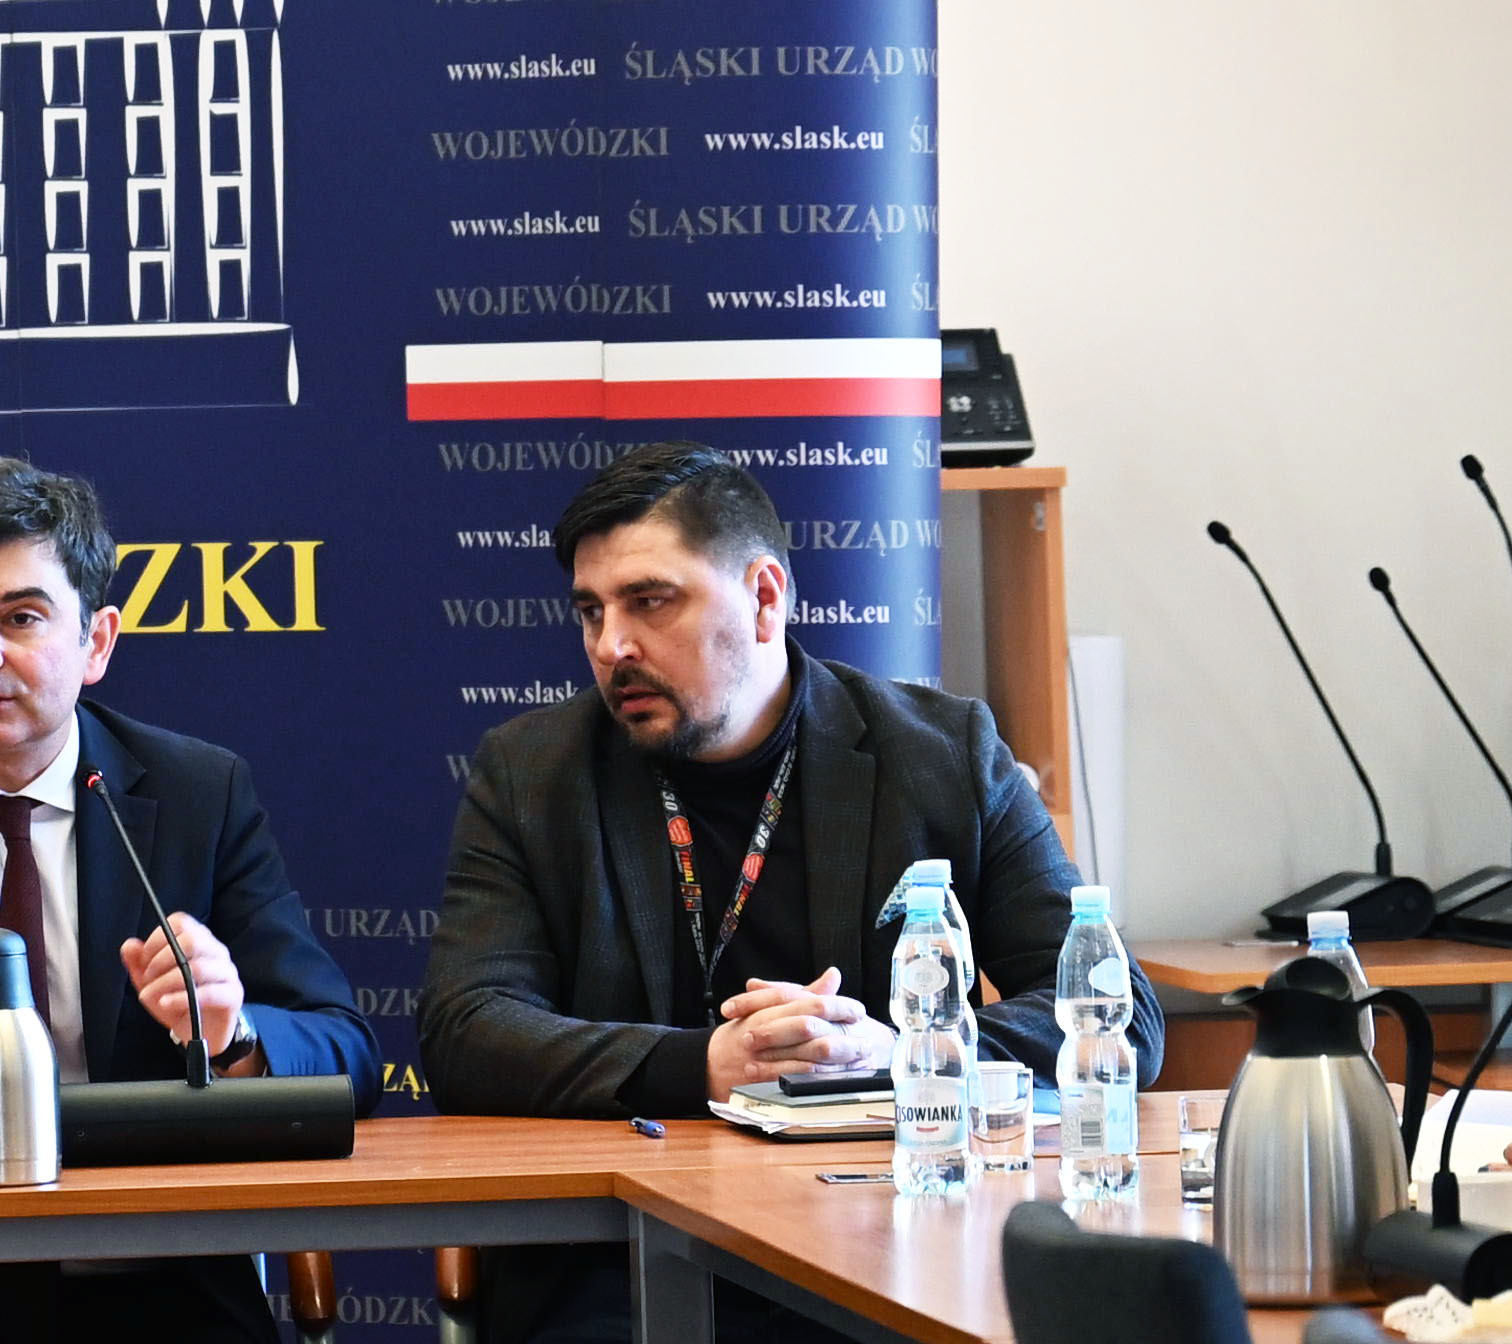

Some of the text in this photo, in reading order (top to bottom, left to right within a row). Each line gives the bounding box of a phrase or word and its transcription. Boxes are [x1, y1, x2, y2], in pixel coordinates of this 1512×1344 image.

[447, 54, 595, 80] www.slask.eu
[625, 41, 760, 85] ŚLĄSKI
[777, 46, 903, 83] URZĄD
[432, 119, 668, 159] WOJEWÓDZKI
[705, 125, 883, 150] www.slask.eu
[451, 211, 599, 236] www.slask.eu
[629, 199, 762, 243] ŚLĄSKI
[779, 204, 905, 242] URZĄD
[436, 275, 670, 315] WOJEWÓDZKI
[707, 284, 885, 308] www.slask.eu
[457, 525, 555, 548] www.sla
[785, 520, 909, 557] URZĄD
[790, 600, 890, 625] slask.eu
[326, 908, 441, 946] URZĄD
